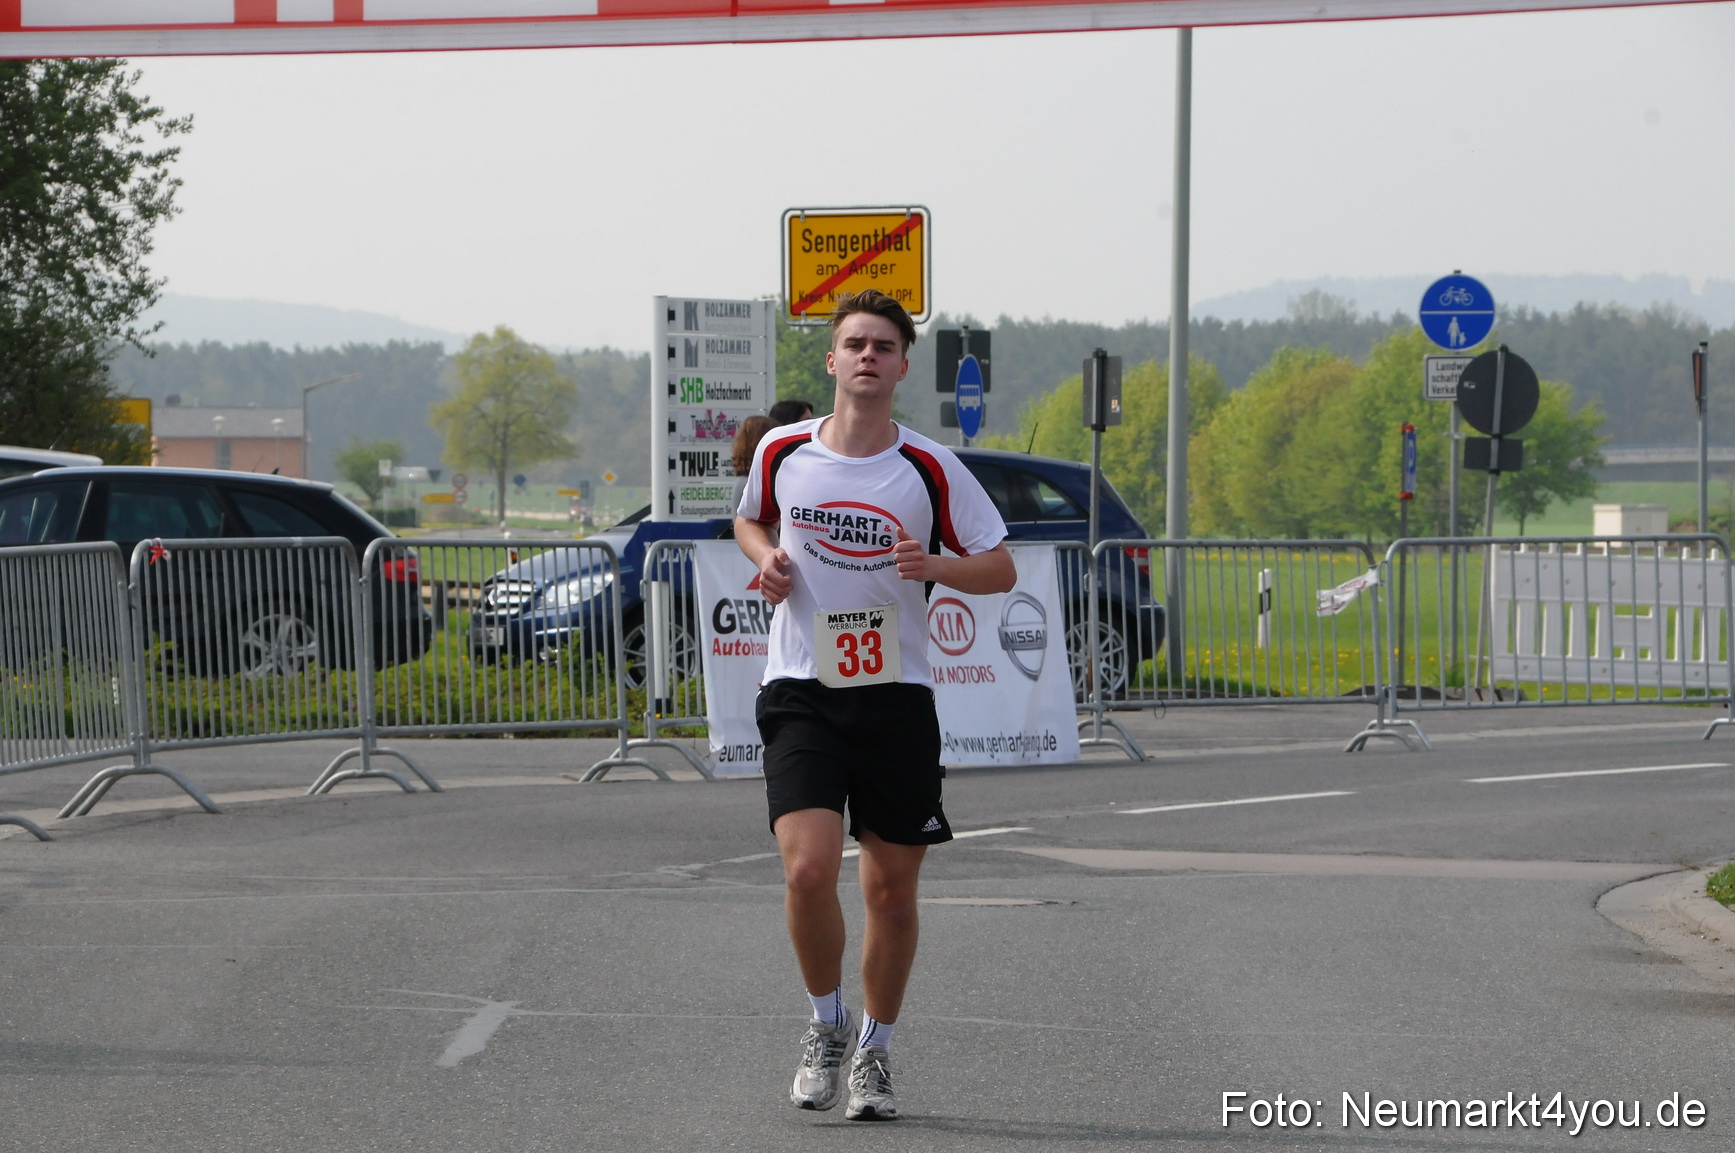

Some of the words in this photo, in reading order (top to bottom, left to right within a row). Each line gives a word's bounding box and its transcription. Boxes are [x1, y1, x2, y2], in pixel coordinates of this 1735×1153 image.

[802, 227, 911, 259] Sengenthal
[816, 264, 840, 276] am
[848, 261, 896, 279] Anger
[798, 290, 823, 303] Kreis
[705, 302, 751, 319] HOLZAMMER
[705, 338, 751, 355] HOLZAMMER
[1436, 361, 1466, 372] Landwi
[680, 377, 704, 404] SHB
[705, 382, 751, 401] Holzfachmarkt
[1431, 385, 1456, 395] Verke
[680, 451, 718, 477] THULE
[681, 486, 732, 501] HEIDELBERGCE
[790, 506, 882, 532] GERHART
[883, 524, 892, 533] &
[792, 521, 830, 533] Autohaus
[829, 528, 893, 547] JÄNIG
[803, 542, 819, 558] Das
[819, 554, 862, 572] sportliche
[863, 558, 898, 572] Autohau
[712, 597, 776, 635] GERH
[828, 612, 867, 624] MEYER
[828, 621, 868, 631] WERBUNG
[936, 612, 969, 642] KIA
[1004, 629, 1046, 644] NISSA
[712, 637, 768, 656] Autohau
[836, 630, 884, 678] 33
[932, 667, 945, 685] IA
[947, 665, 996, 685] MOTORS
